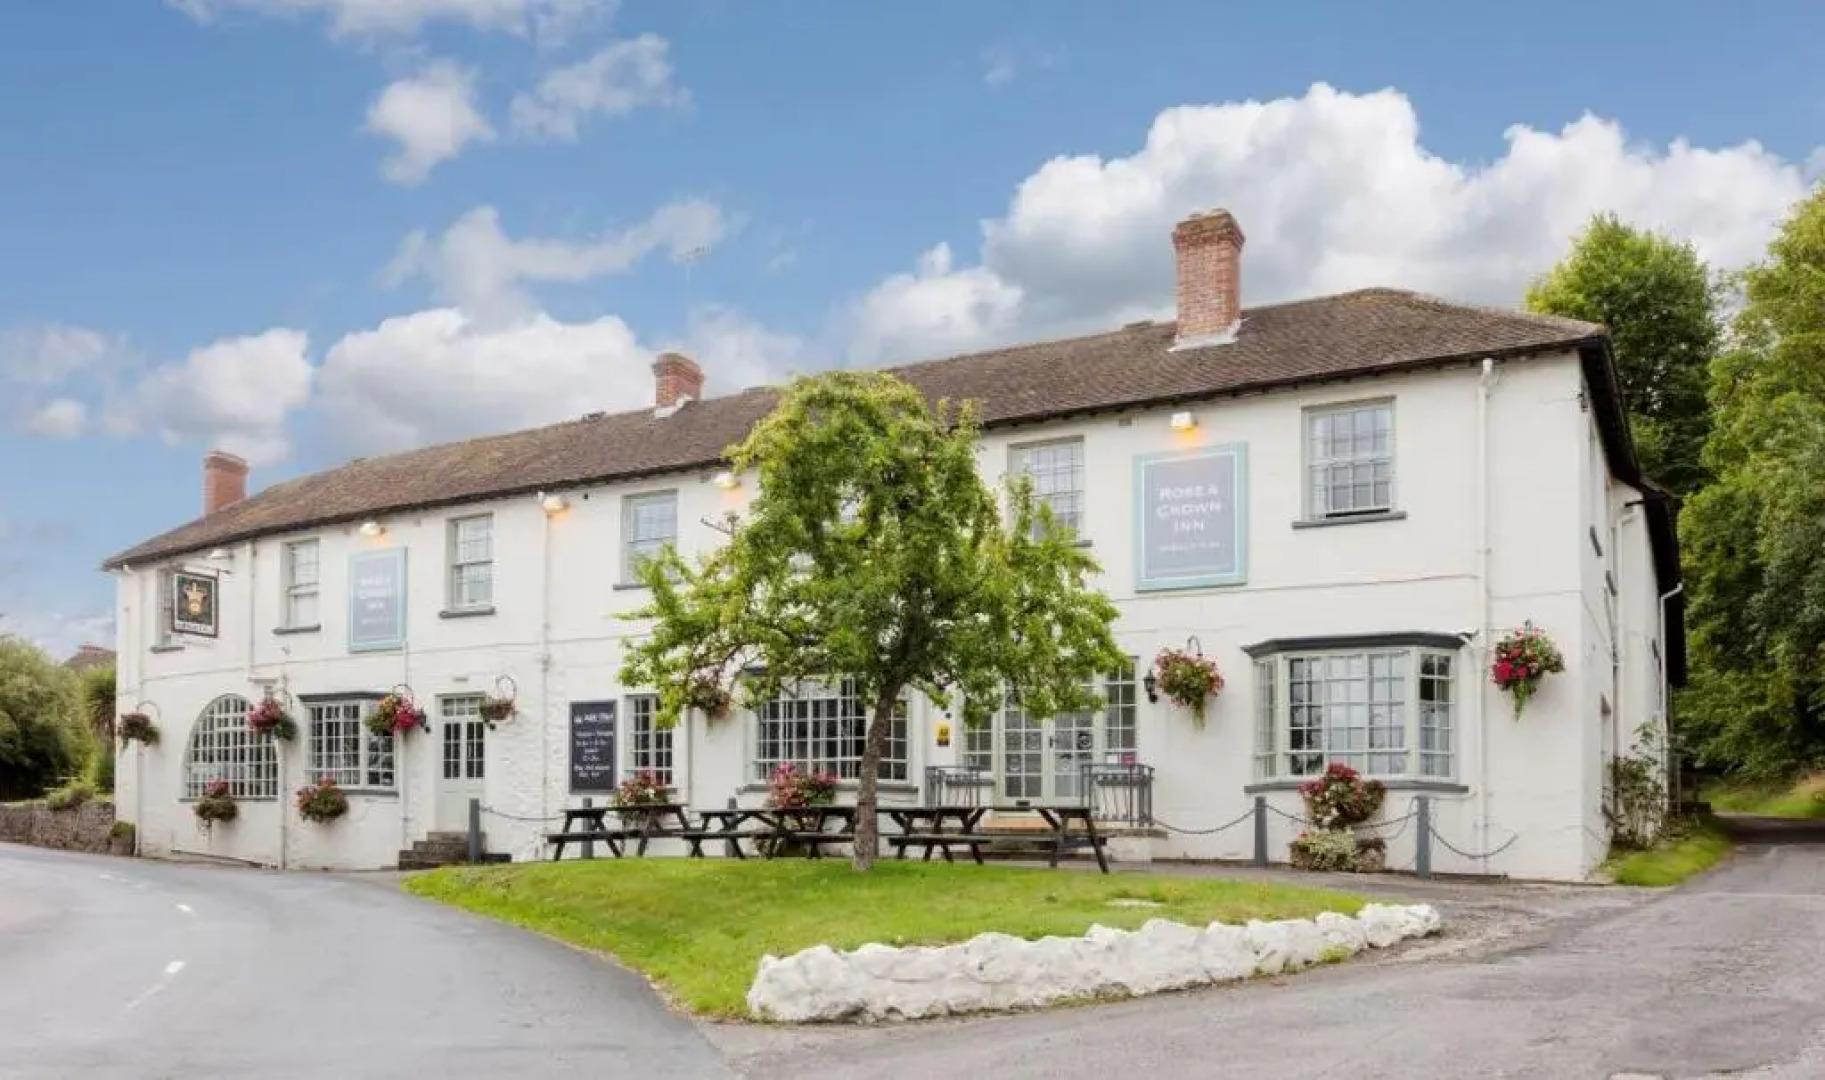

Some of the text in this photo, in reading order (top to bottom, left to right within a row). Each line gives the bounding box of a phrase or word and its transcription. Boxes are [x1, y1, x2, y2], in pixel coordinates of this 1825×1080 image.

[1159, 486, 1204, 500] ROSE
[1157, 502, 1221, 517] CROWN
[1174, 519, 1204, 531] INN
